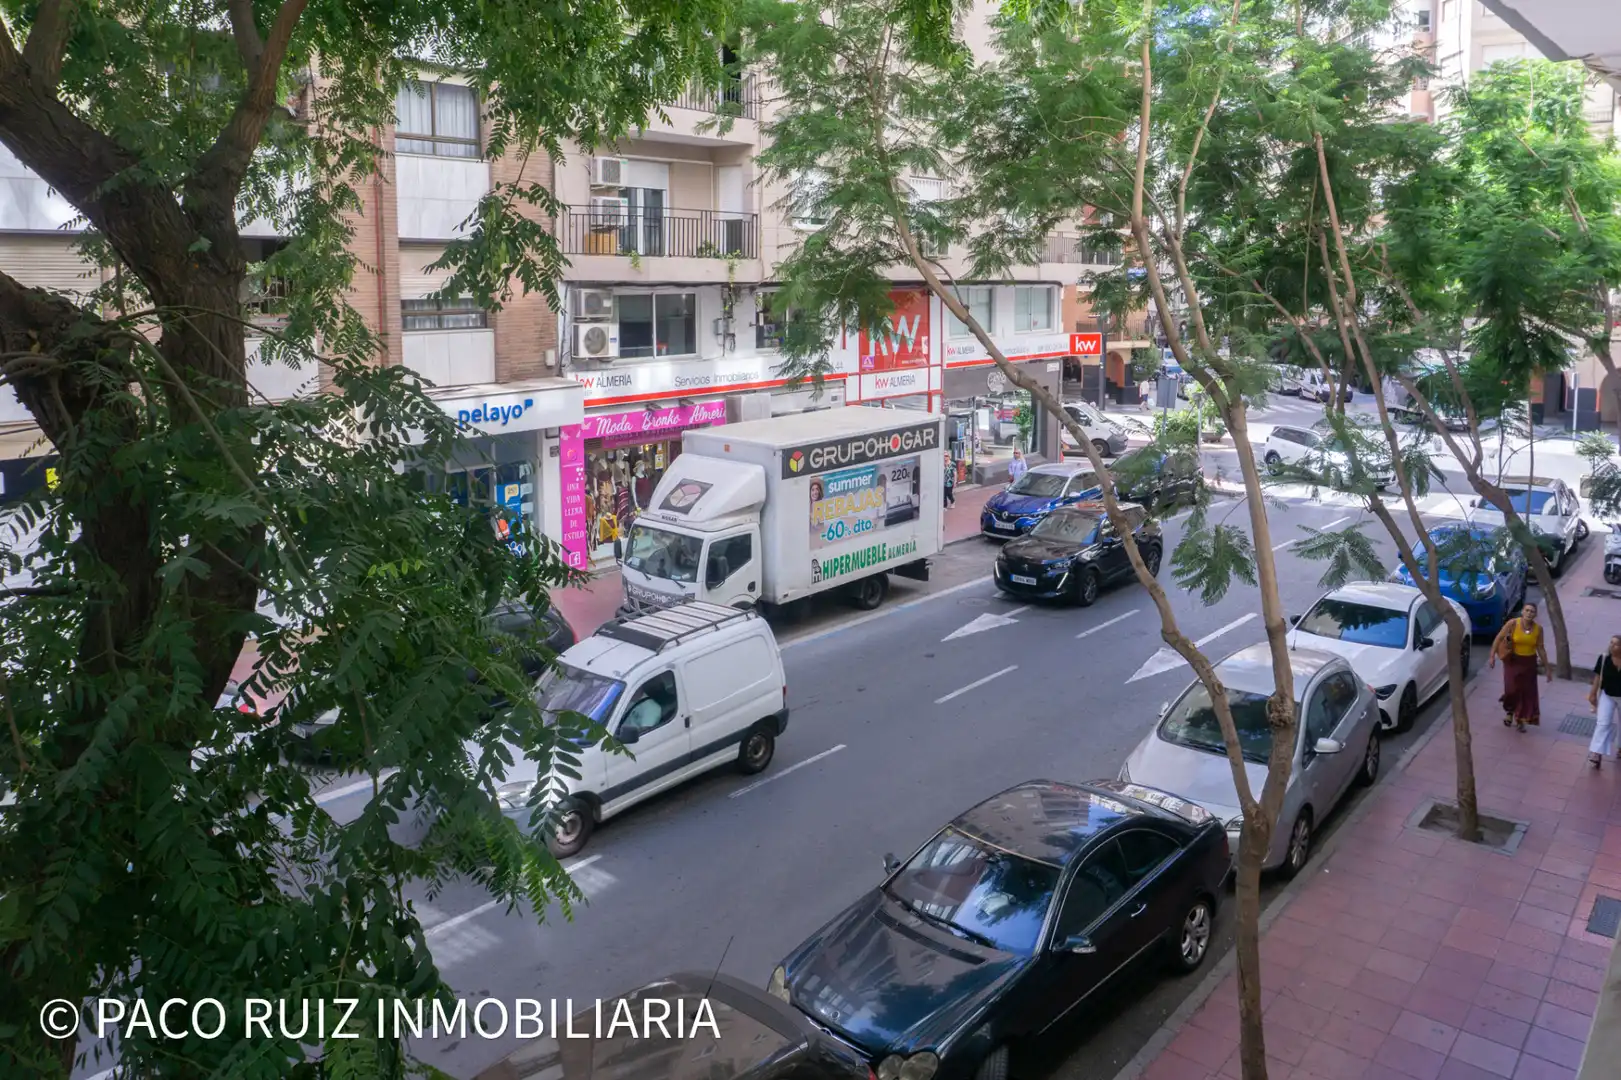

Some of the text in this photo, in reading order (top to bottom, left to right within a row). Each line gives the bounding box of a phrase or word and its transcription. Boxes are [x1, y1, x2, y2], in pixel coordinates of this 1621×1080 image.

[1075, 336, 1096, 352] kw
[674, 375, 711, 388] Servicios
[875, 375, 890, 389] kw
[458, 403, 523, 428] pelayo
[596, 414, 633, 436] Moda
[642, 410, 681, 431] Bronko
[809, 428, 935, 469] GRUPOHOGAR
[567, 482, 579, 492] UNA
[828, 474, 873, 494] summer
[566, 494, 581, 504] VIDA
[812, 486, 885, 525] REBAJAS
[564, 506, 583, 516] LLENA
[570, 519, 578, 528] DE
[821, 520, 851, 541] -60%
[564, 531, 585, 541] ESTILO
[822, 543, 887, 580] HIPERMUEBLE
